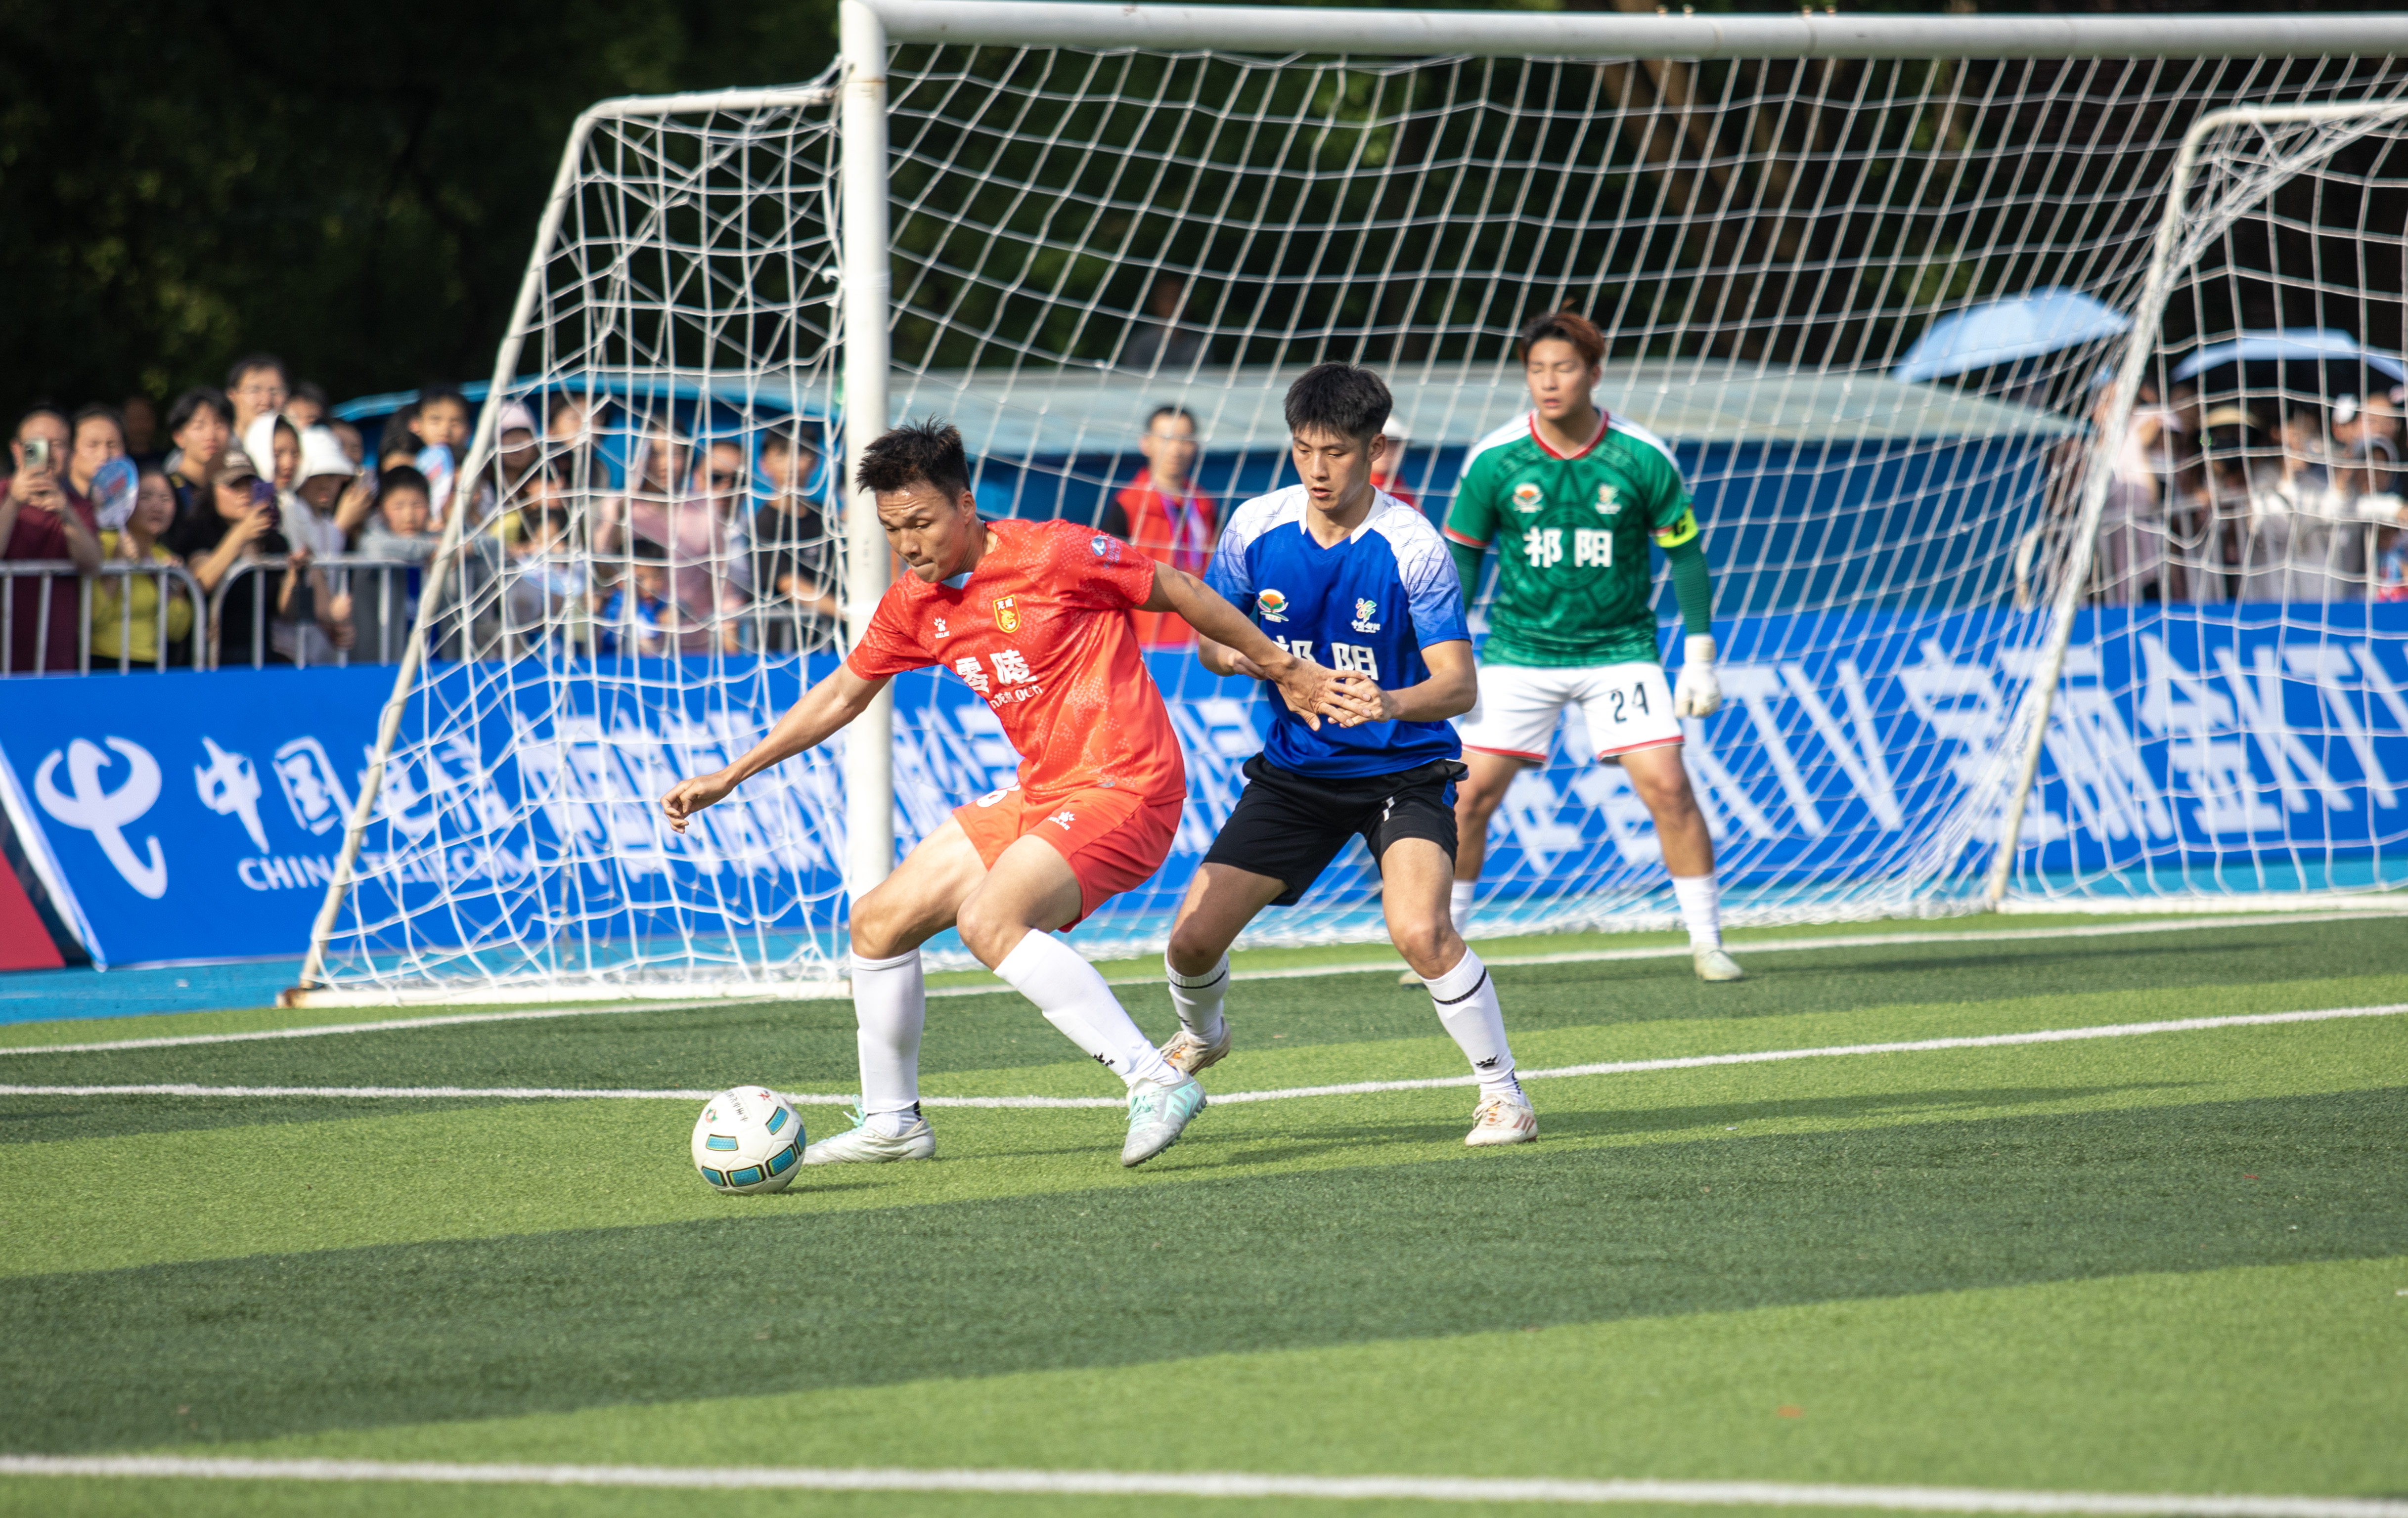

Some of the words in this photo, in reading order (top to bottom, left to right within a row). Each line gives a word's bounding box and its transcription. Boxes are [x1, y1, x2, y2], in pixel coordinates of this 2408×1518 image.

[1522, 525, 1613, 568] 祁阳
[955, 649, 1037, 693] 零陵
[1610, 682, 1649, 724] 24
[237, 854, 364, 891] CHIN
